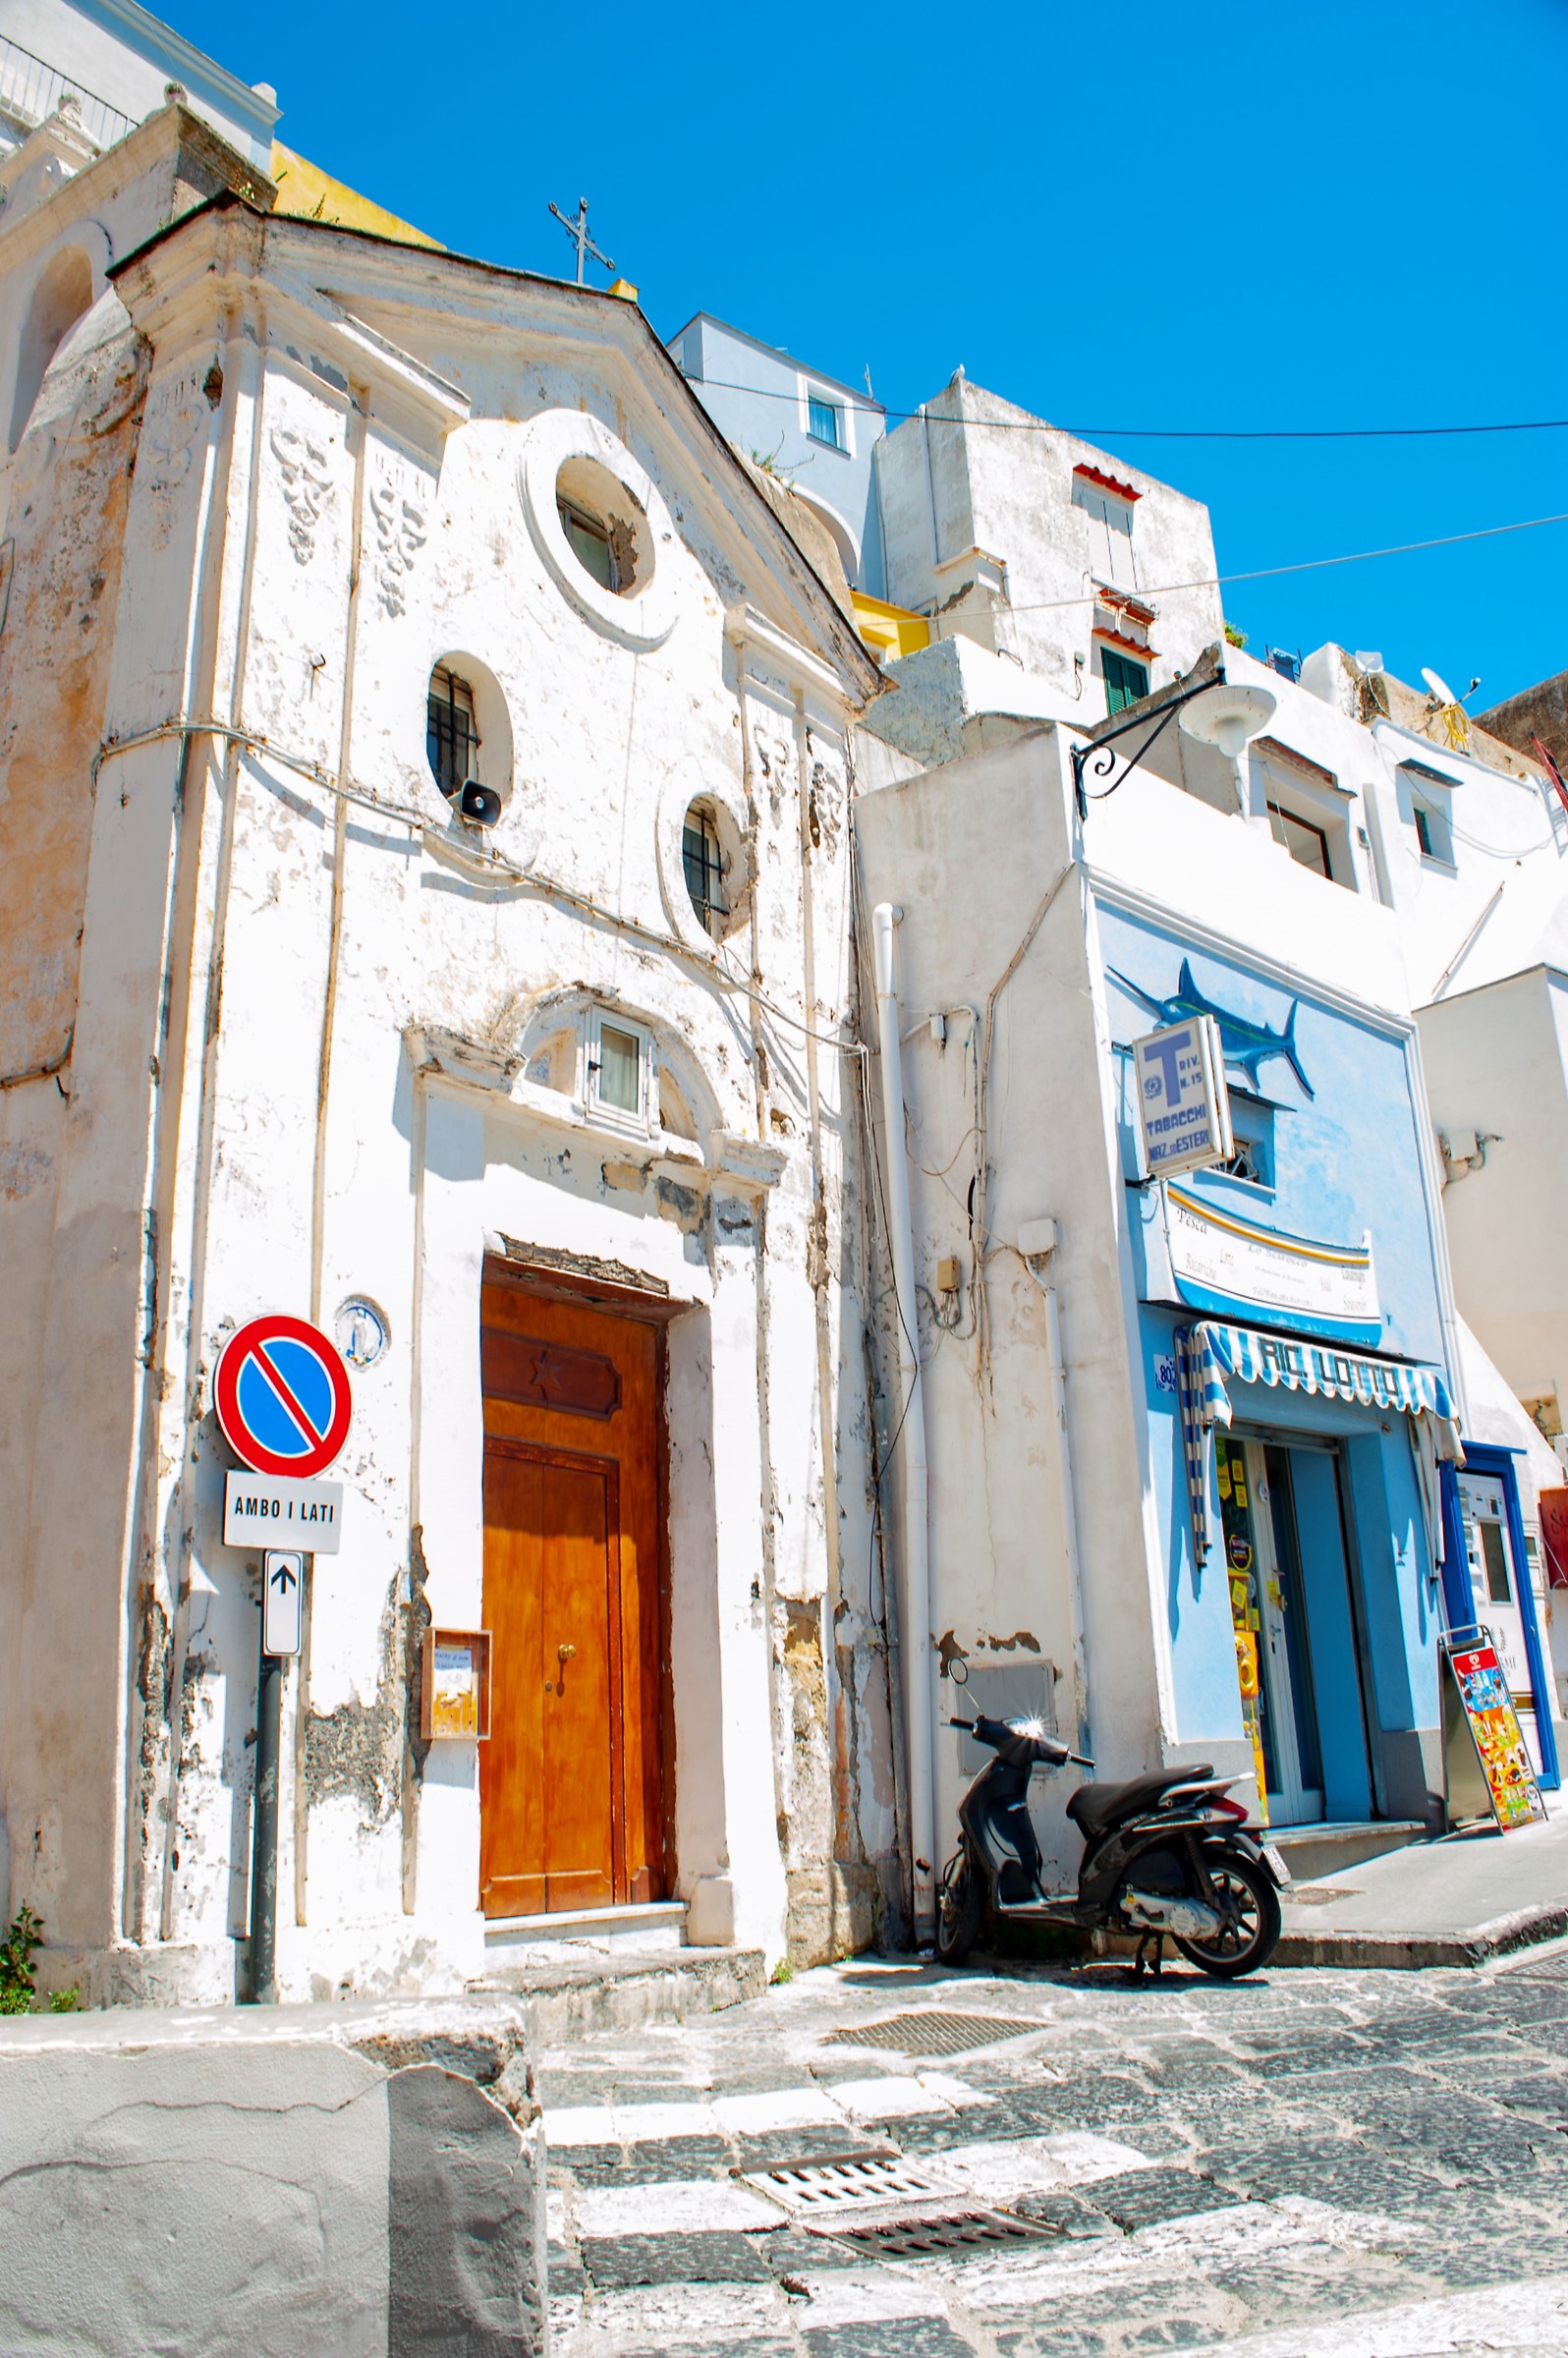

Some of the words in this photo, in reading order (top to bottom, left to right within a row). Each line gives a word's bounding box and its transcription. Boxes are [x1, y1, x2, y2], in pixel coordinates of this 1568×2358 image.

[1144, 1031, 1192, 1108] T
[1179, 1054, 1201, 1071] RIV.
[1180, 1077, 1190, 1090] N.
[1191, 1072, 1203, 1086] 15
[1147, 1103, 1206, 1136] TABACCHI
[1176, 1129, 1210, 1153] ESTERI
[1177, 1207, 1207, 1235] Pesca
[1159, 1365, 1172, 1383] 80
[1259, 1337, 1309, 1377] RIC.
[1318, 1351, 1400, 1396] LOTTO
[235, 1496, 280, 1518] AMBO
[288, 1500, 294, 1519] I
[301, 1502, 334, 1523] LATI
